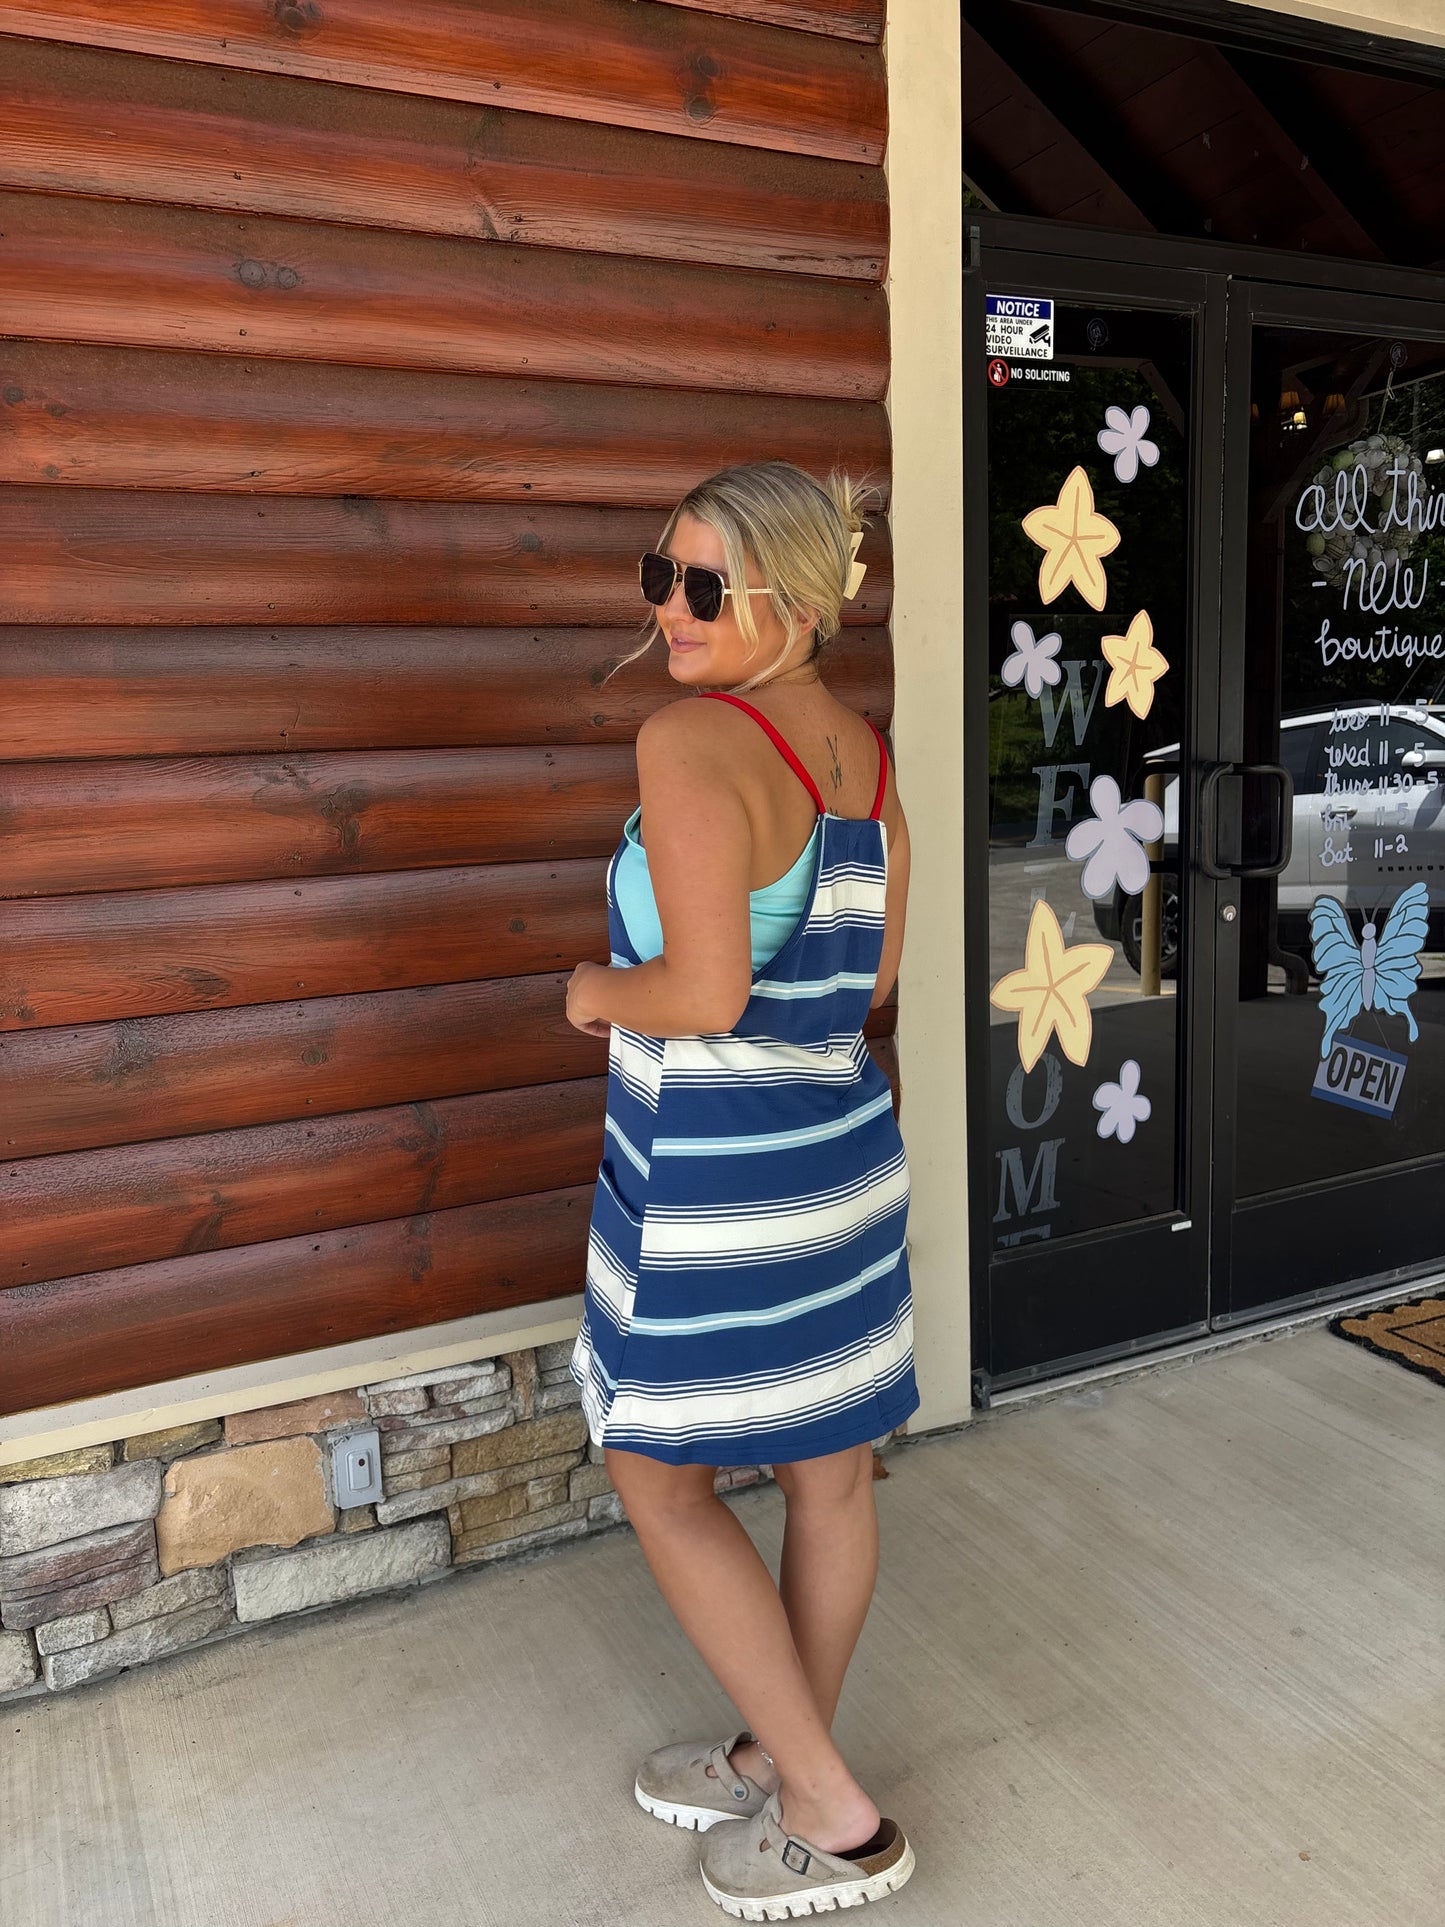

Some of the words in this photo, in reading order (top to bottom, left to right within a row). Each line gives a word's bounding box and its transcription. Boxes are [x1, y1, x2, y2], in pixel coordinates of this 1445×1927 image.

[996, 300, 1040, 317] NOTICE
[986, 324, 996, 333] 24
[1001, 325, 1024, 335] HOUR
[986, 334, 1012, 344] VIDEO
[986, 345, 1048, 357] SURVEILLANCE
[1011, 368, 1023, 379] NO
[1025, 369, 1070, 382] SOLICITING
[1296, 463, 1376, 534] all
[1315, 618, 1445, 668] boutique
[1326, 1047, 1400, 1105] OPEN
